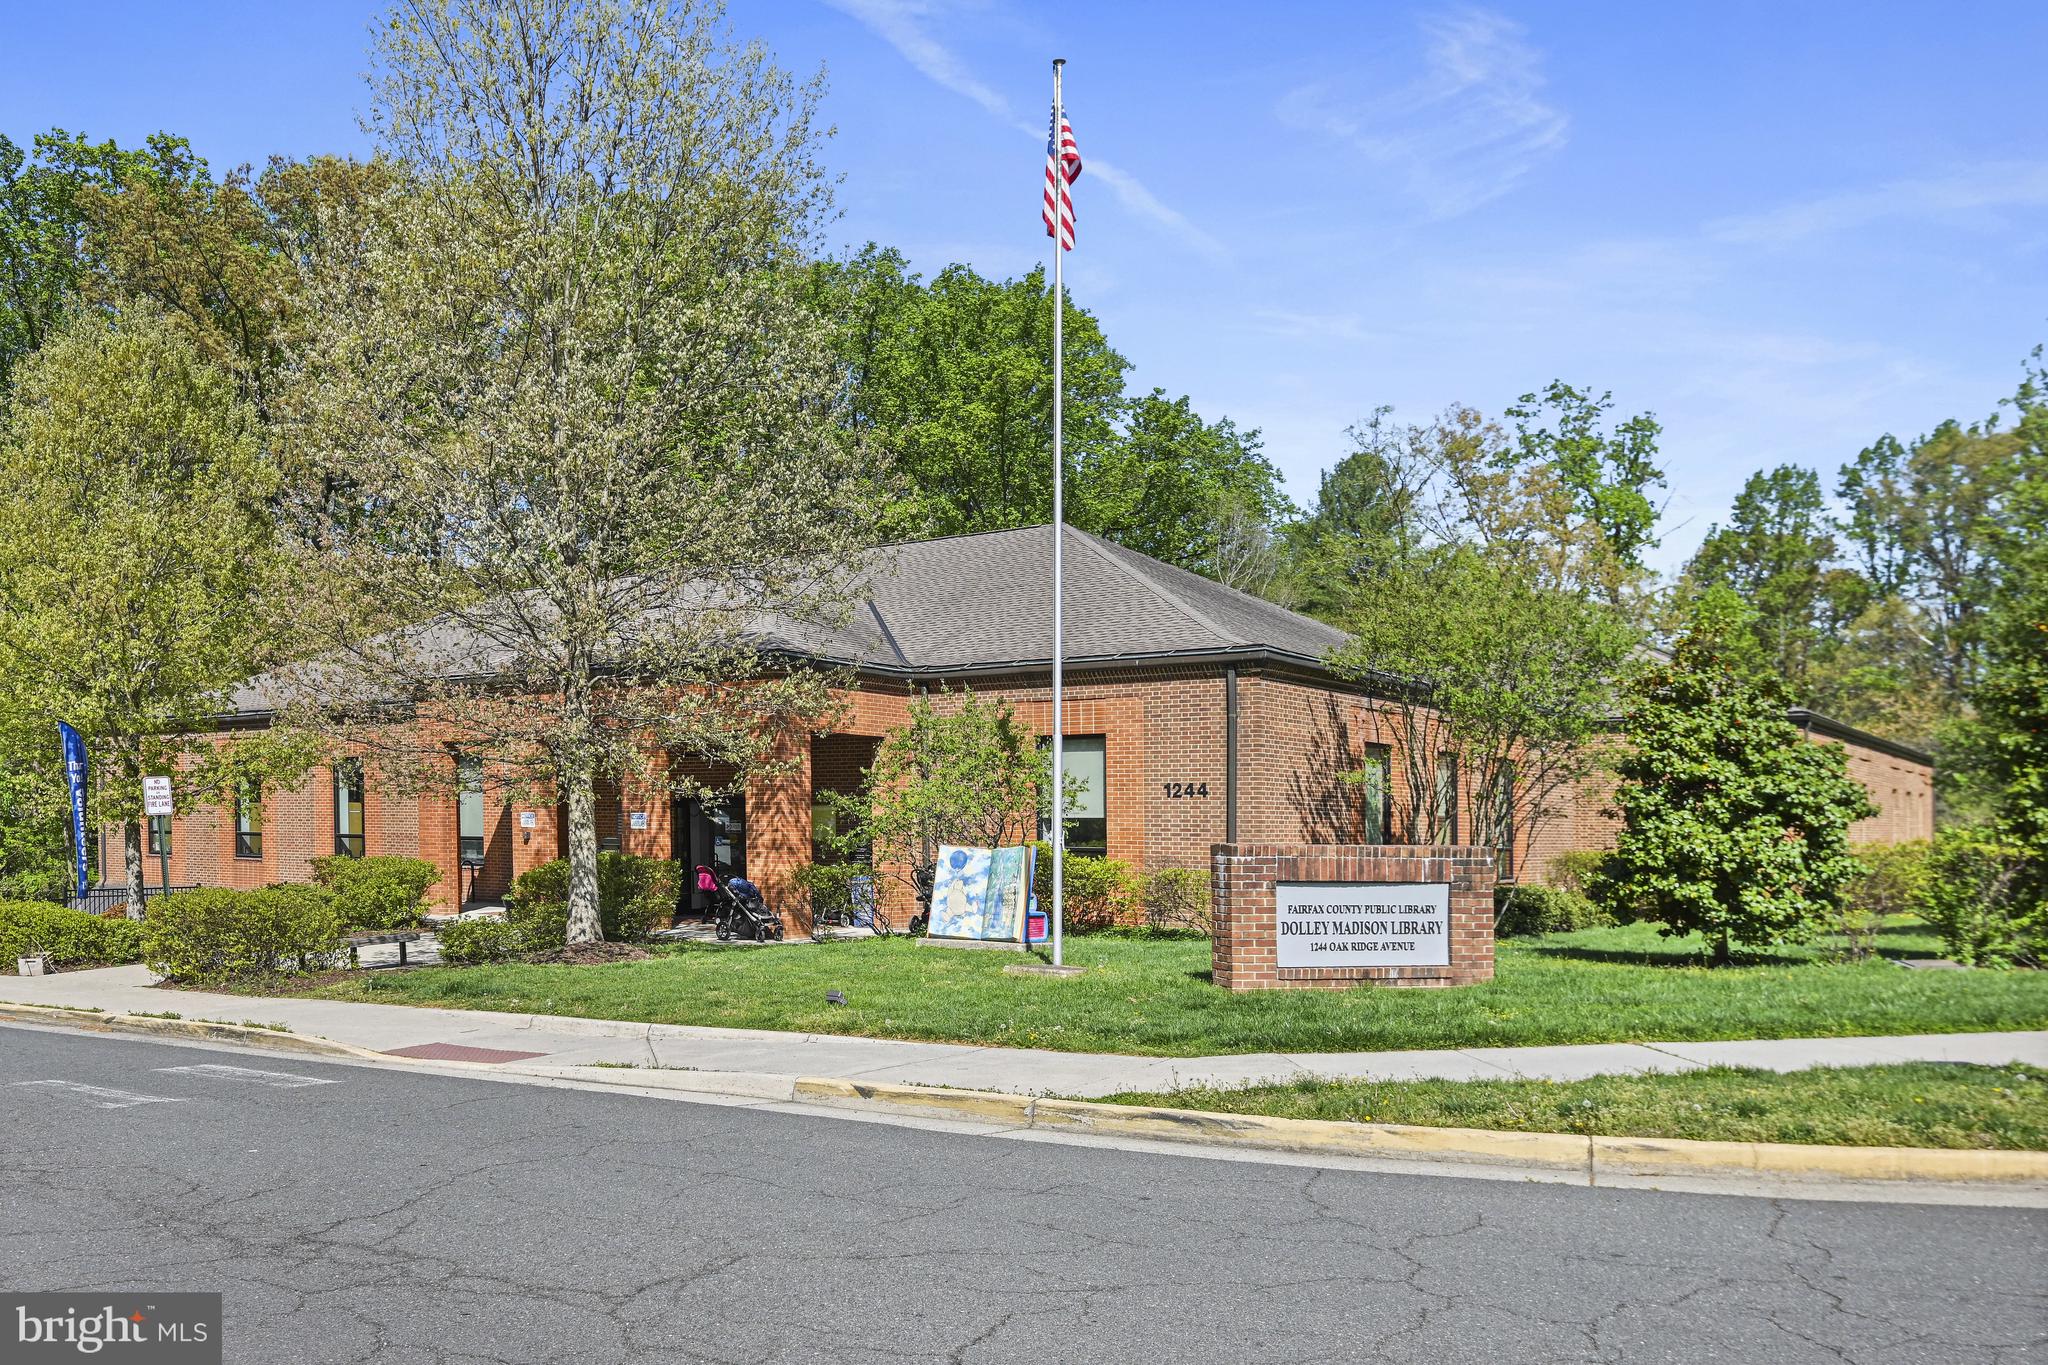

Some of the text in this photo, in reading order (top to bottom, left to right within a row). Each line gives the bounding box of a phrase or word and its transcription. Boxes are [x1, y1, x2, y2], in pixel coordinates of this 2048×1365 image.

[1163, 782, 1208, 798] 1244
[1287, 904, 1437, 914] FAIRFAX COUNTY PUBLIC LIBRARY
[1281, 920, 1443, 935] DOLLEY MADISON LIBRARY
[1310, 942, 1415, 951] 1244 OAK RIDGE AVENUE
